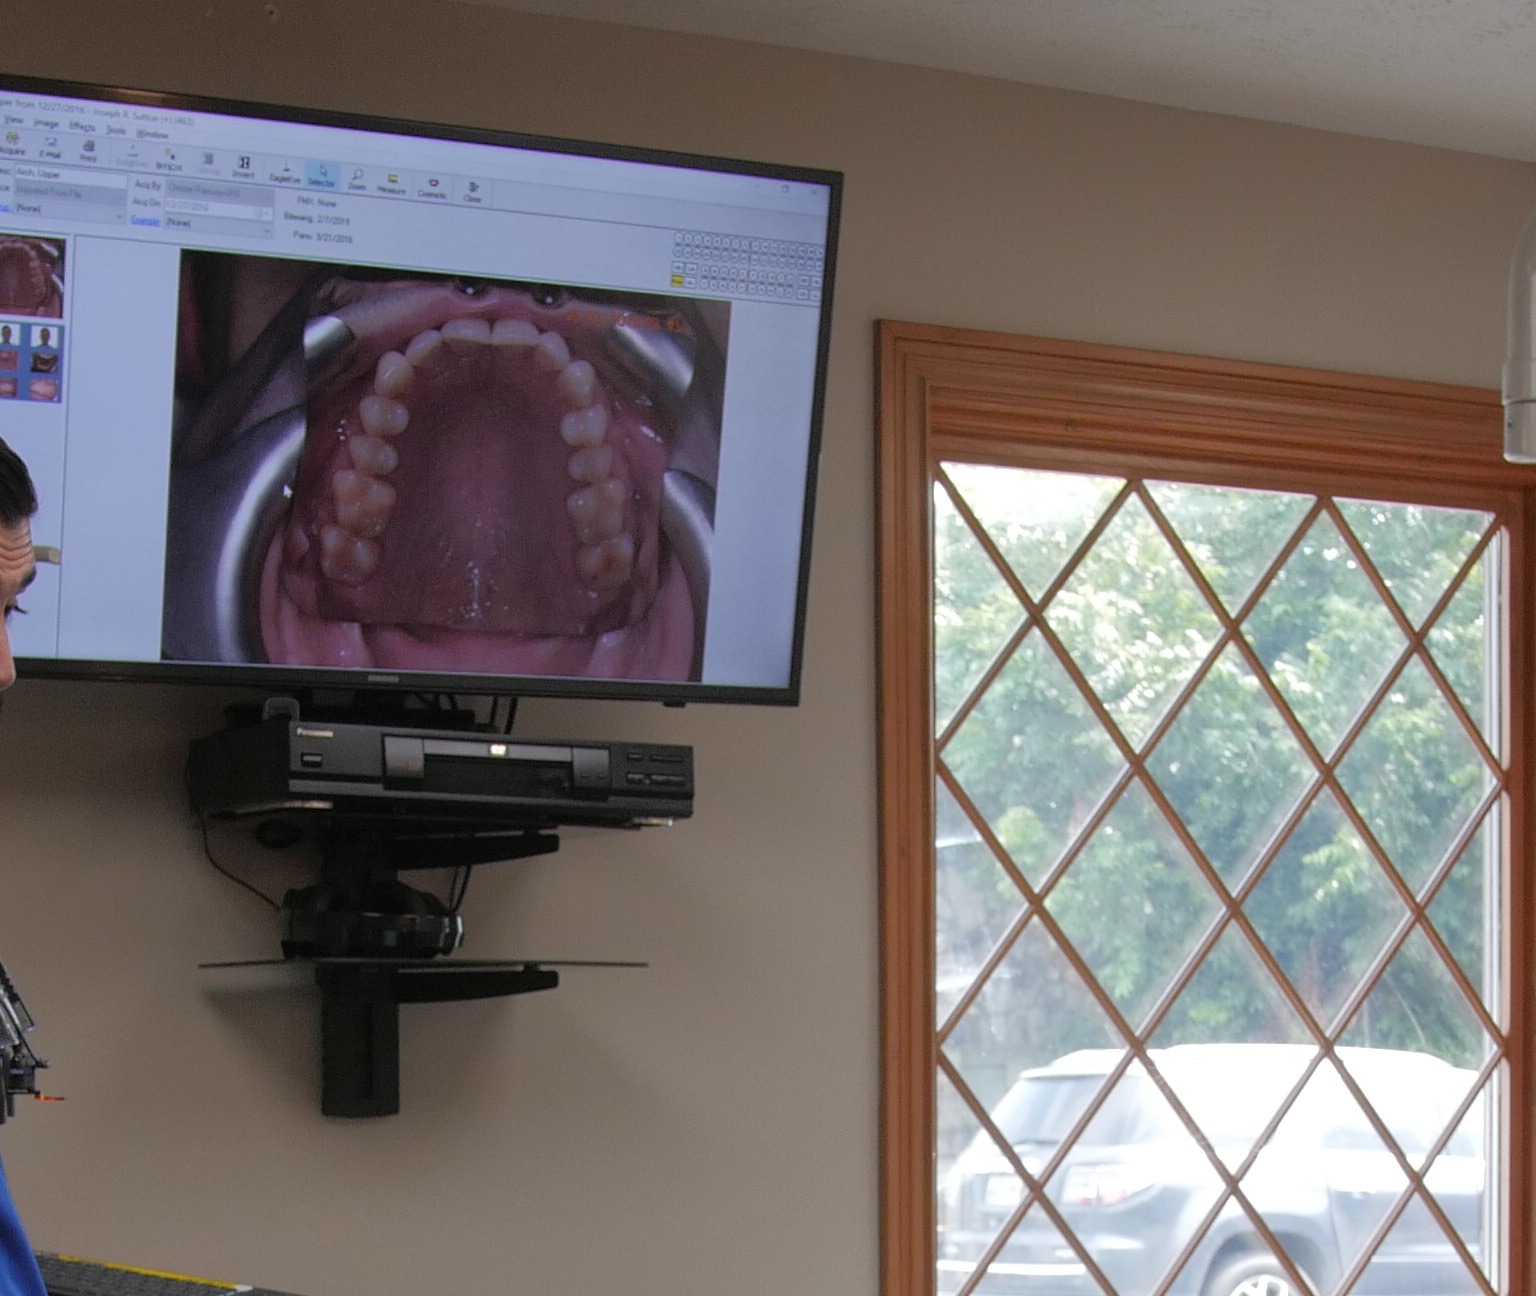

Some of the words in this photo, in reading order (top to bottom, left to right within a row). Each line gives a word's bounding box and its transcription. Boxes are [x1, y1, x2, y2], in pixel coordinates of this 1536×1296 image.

[4, 114, 24, 124] View
[34, 118, 60, 130] Image
[69, 121, 97, 133] Effects
[106, 124, 127, 136] Tools
[136, 129, 169, 140] Window
[79, 153, 97, 163] Print
[232, 169, 255, 180] Invert
[269, 173, 301, 185] EagleEye
[307, 177, 336, 188] Selector
[348, 182, 367, 192] Zoom
[377, 185, 406, 197] Measure
[317, 198, 337, 208] None
[463, 193, 482, 204] Close
